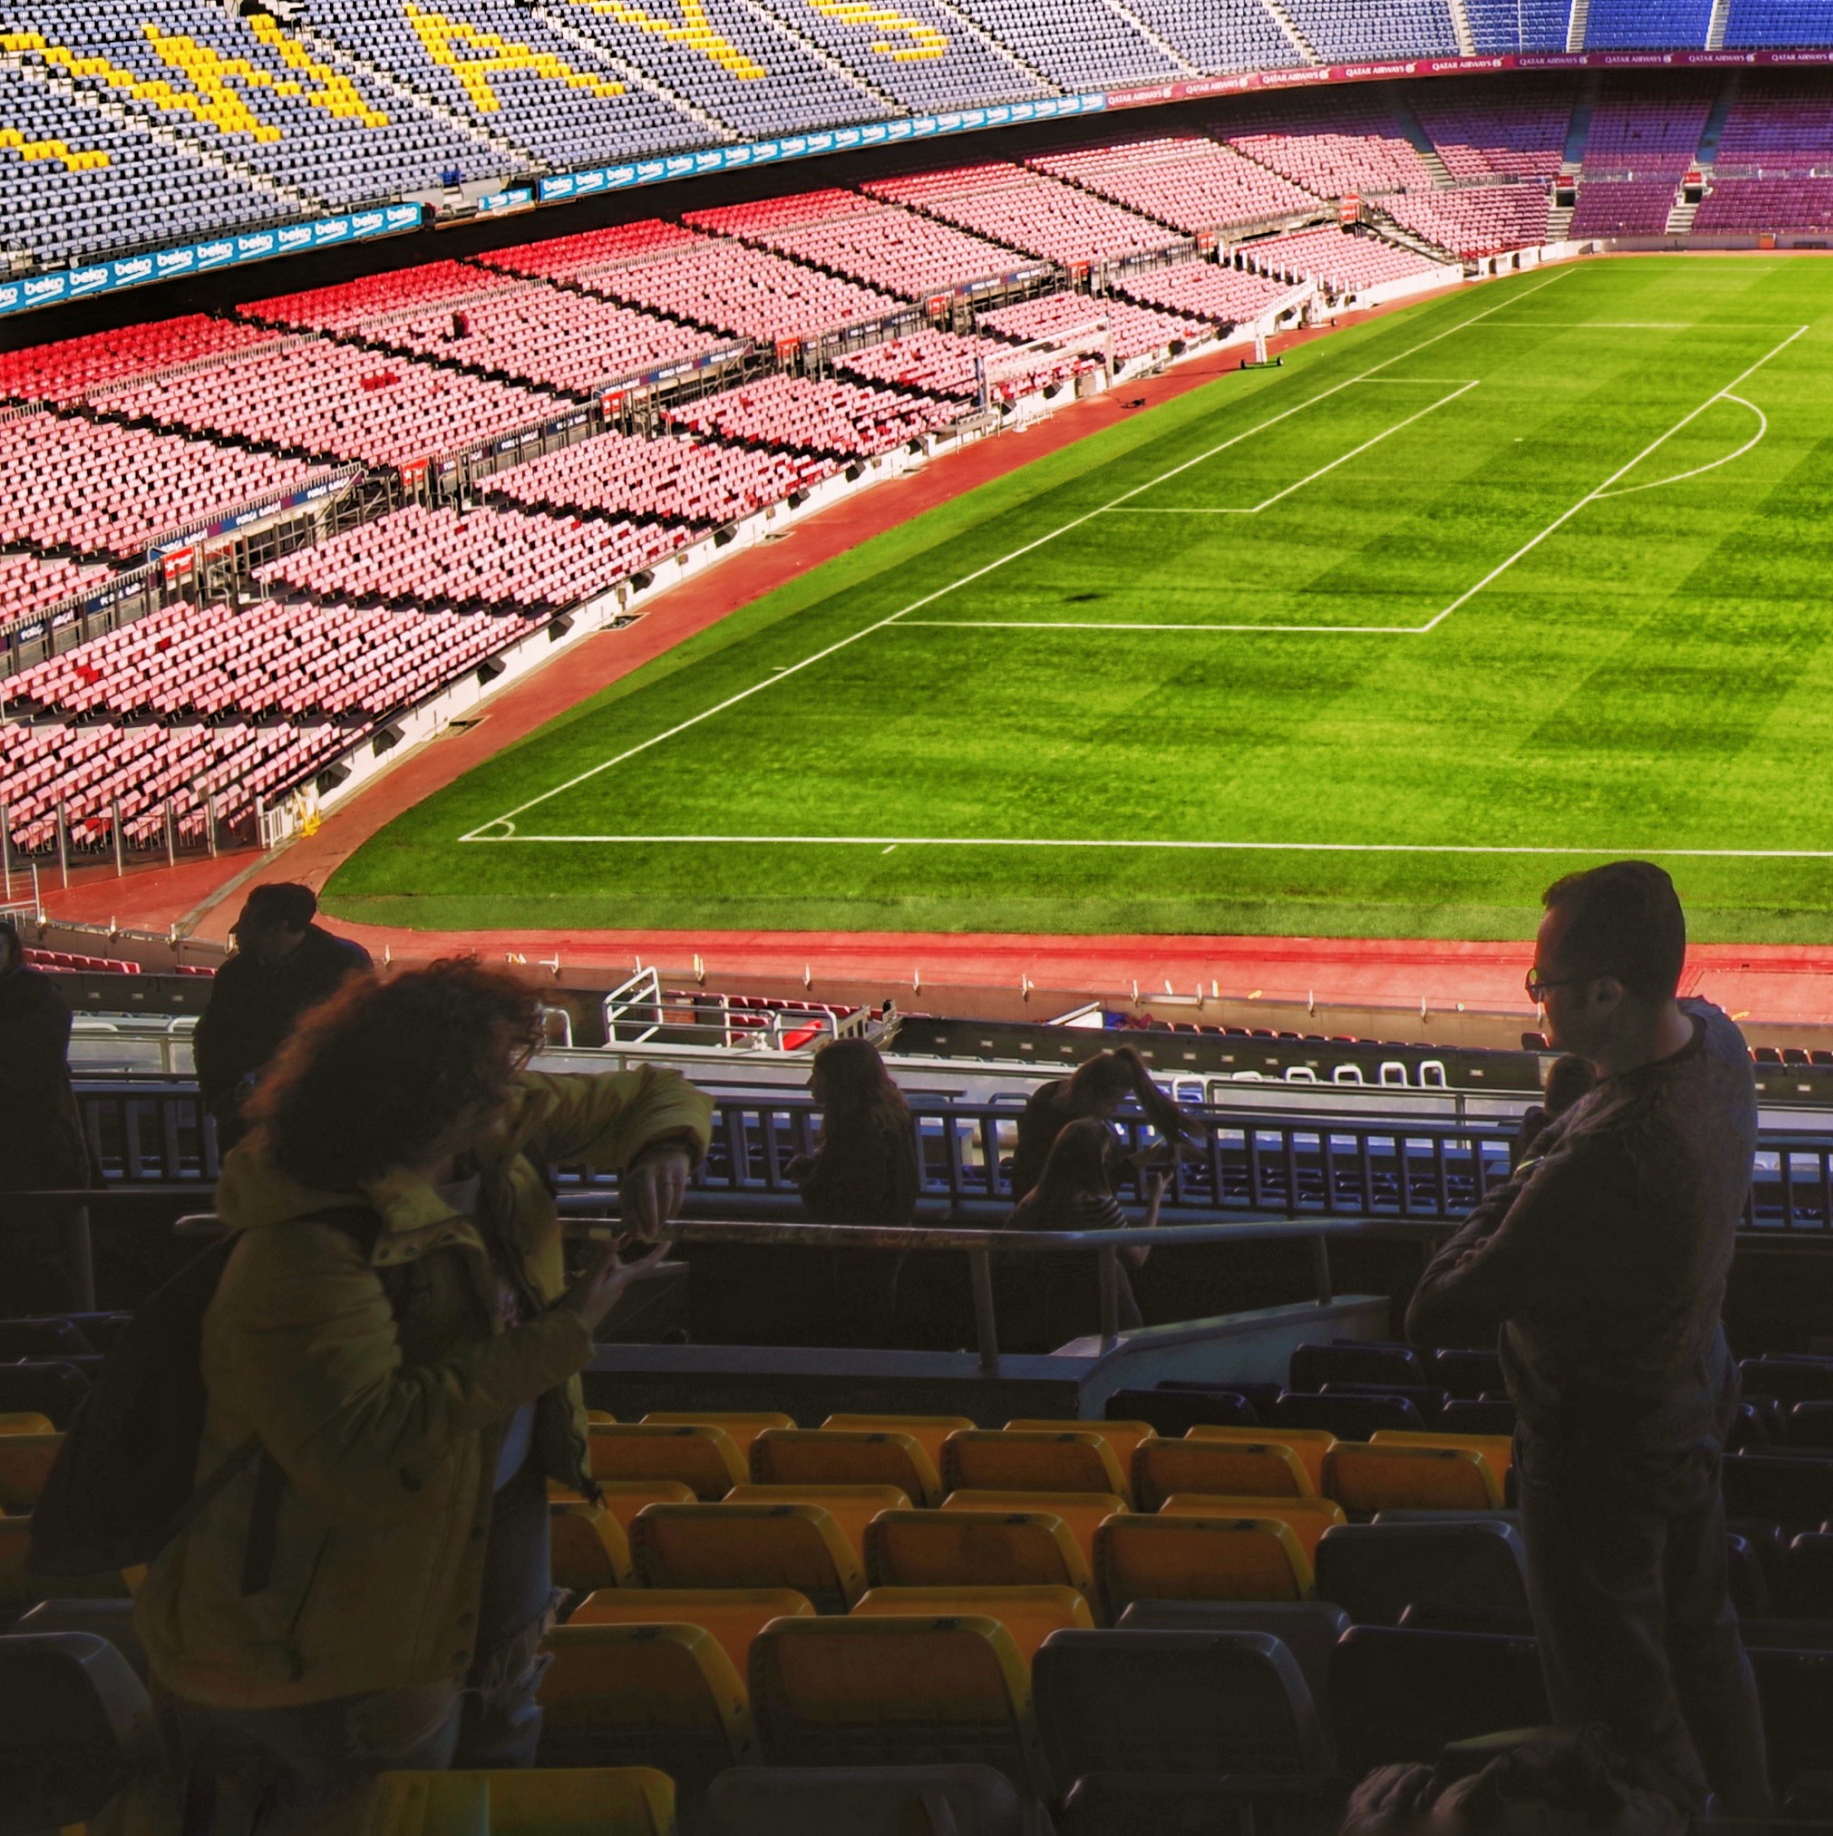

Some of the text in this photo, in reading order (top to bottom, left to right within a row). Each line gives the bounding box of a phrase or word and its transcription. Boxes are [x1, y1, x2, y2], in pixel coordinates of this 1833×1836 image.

[352, 213, 382, 230] beko
[387, 206, 417, 221] beko
[278, 225, 312, 243] beko
[314, 221, 348, 237] beko
[197, 241, 233, 260] beko
[238, 233, 272, 251] beko
[114, 258, 152, 276] beko
[157, 249, 193, 268] beko
[70, 267, 108, 286] beko
[24, 276, 64, 296] beko
